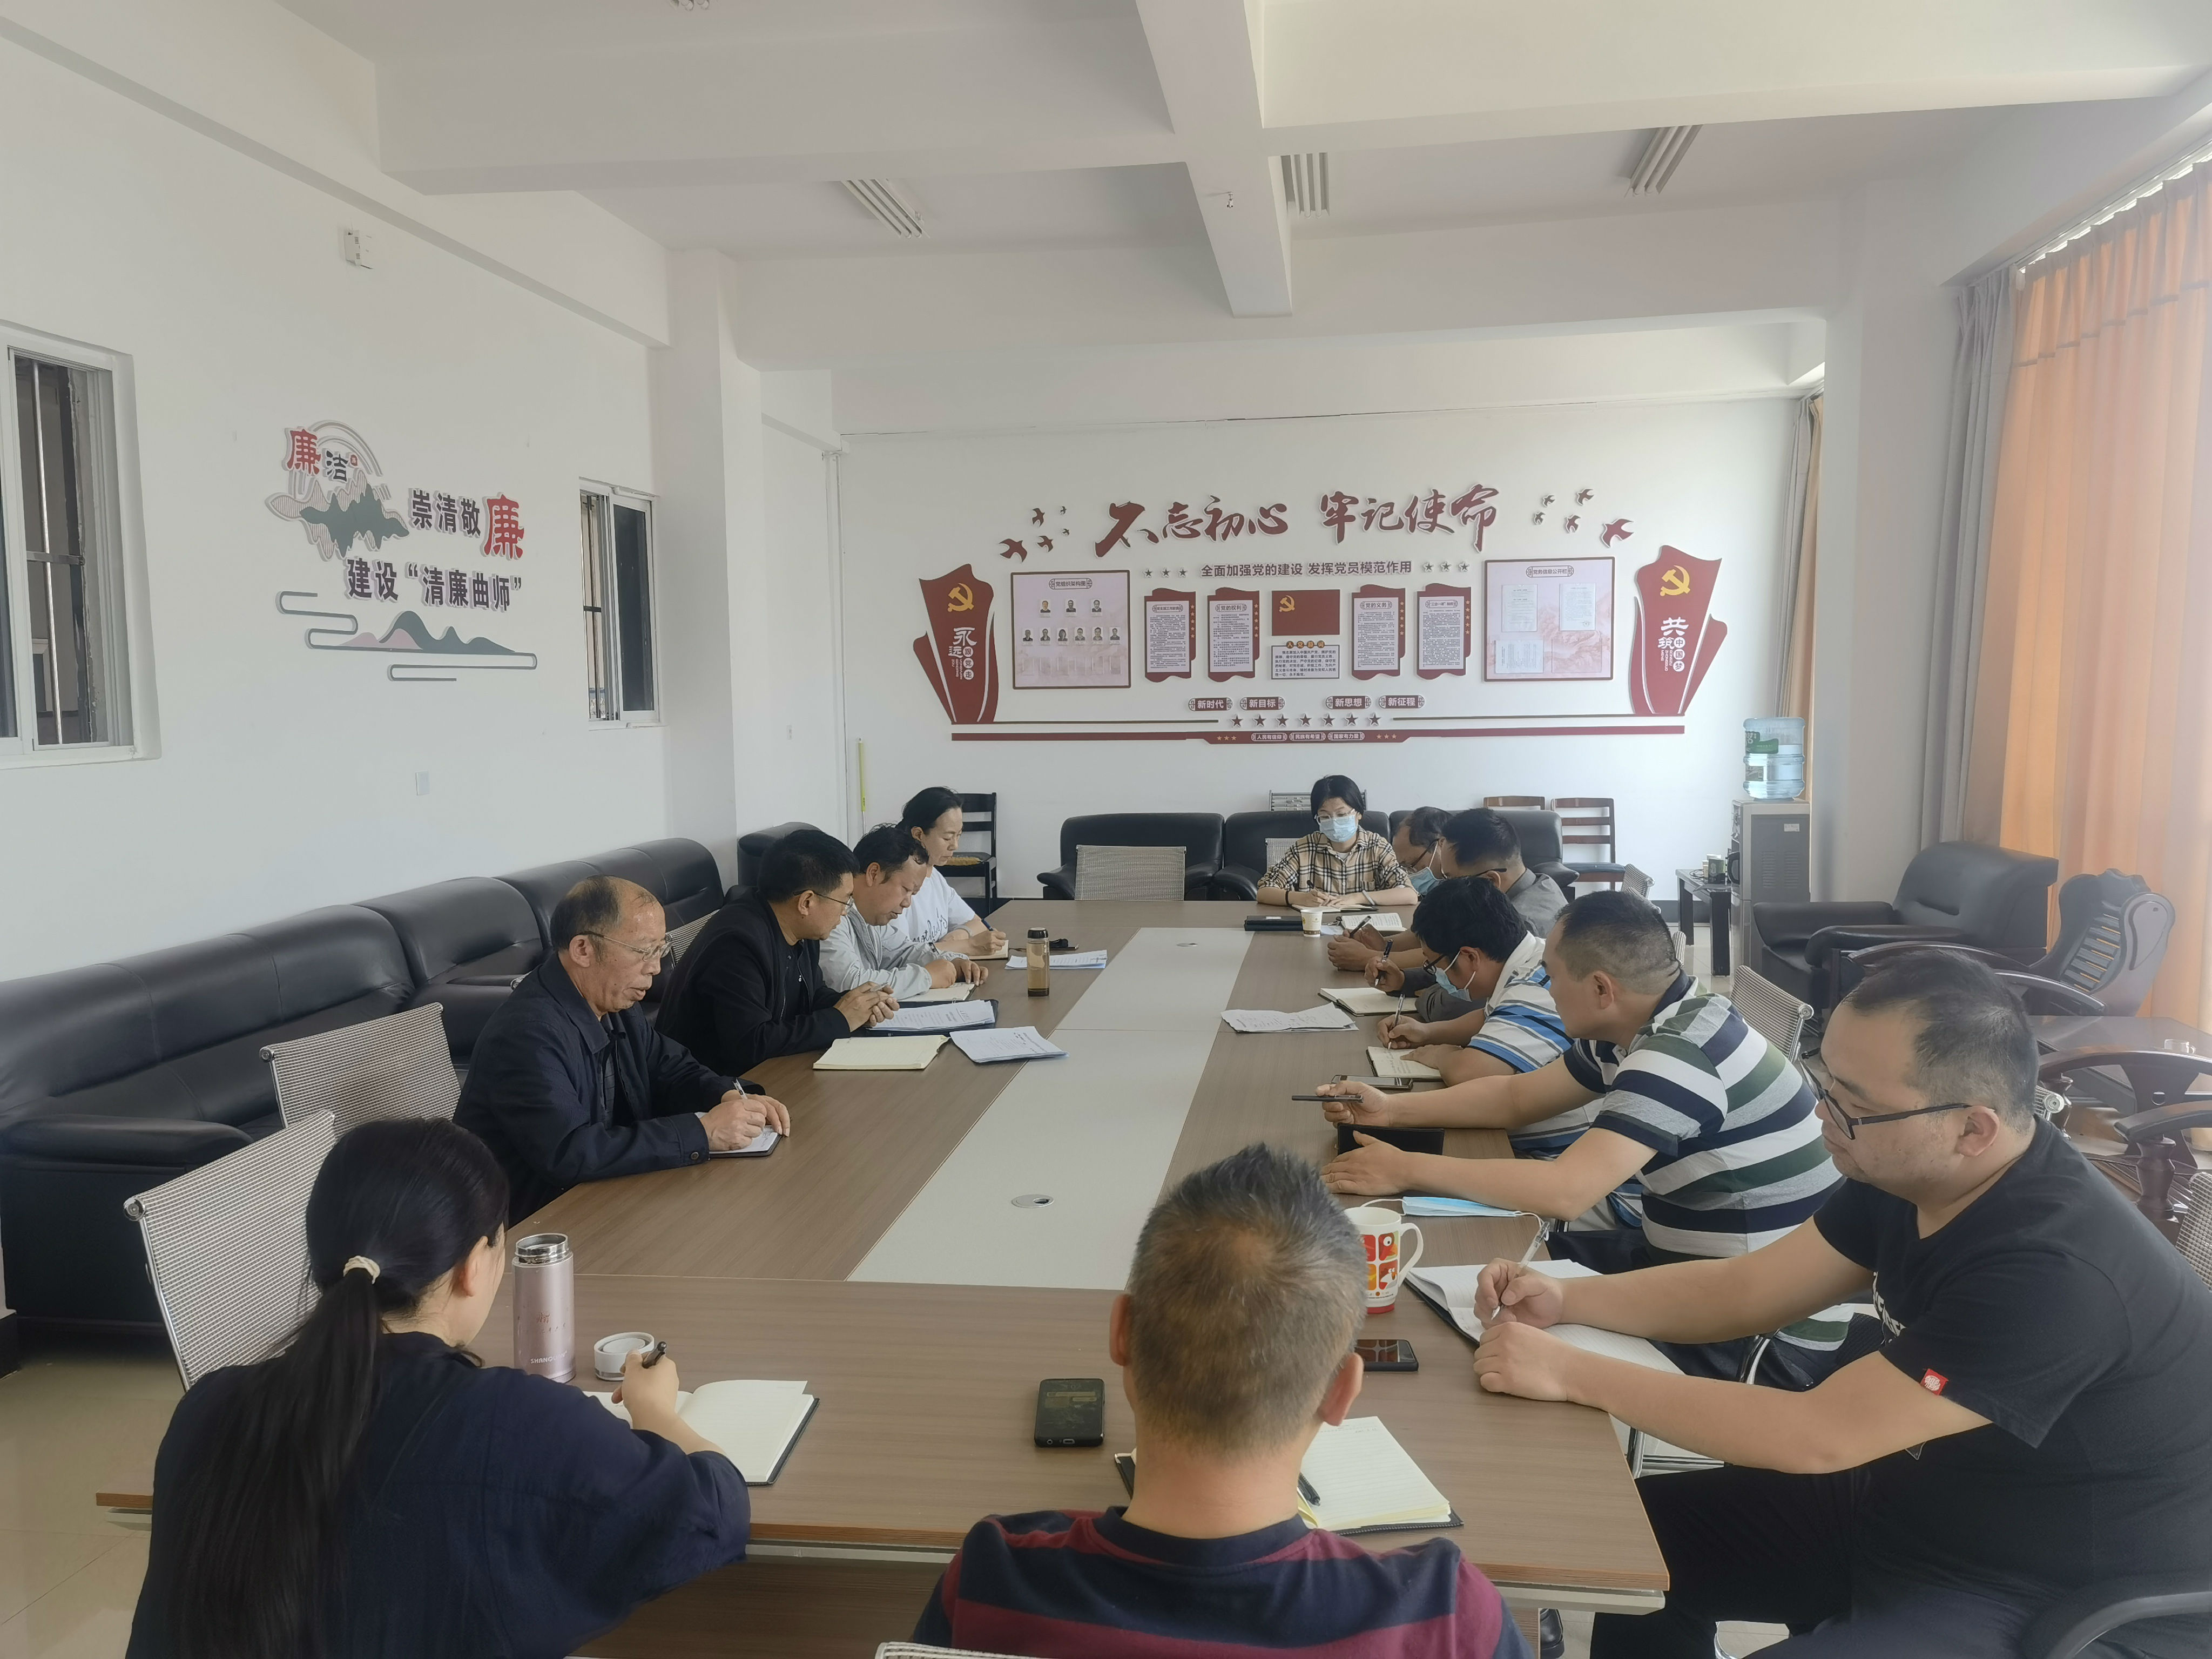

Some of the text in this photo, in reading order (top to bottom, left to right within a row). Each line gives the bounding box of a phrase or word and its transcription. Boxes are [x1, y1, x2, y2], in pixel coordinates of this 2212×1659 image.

[412, 489, 524, 558] 崇清敬廉
[1095, 484, 1499, 557] 不忘初心 牢记使命
[1202, 561, 1411, 577] 全面加强党的建设 发挥党员模范作用
[1197, 700, 1224, 709] 新时代
[1249, 699, 1276, 708] 新目标
[1335, 698, 1363, 707] 新思想
[1388, 697, 1415, 706] 新征程
